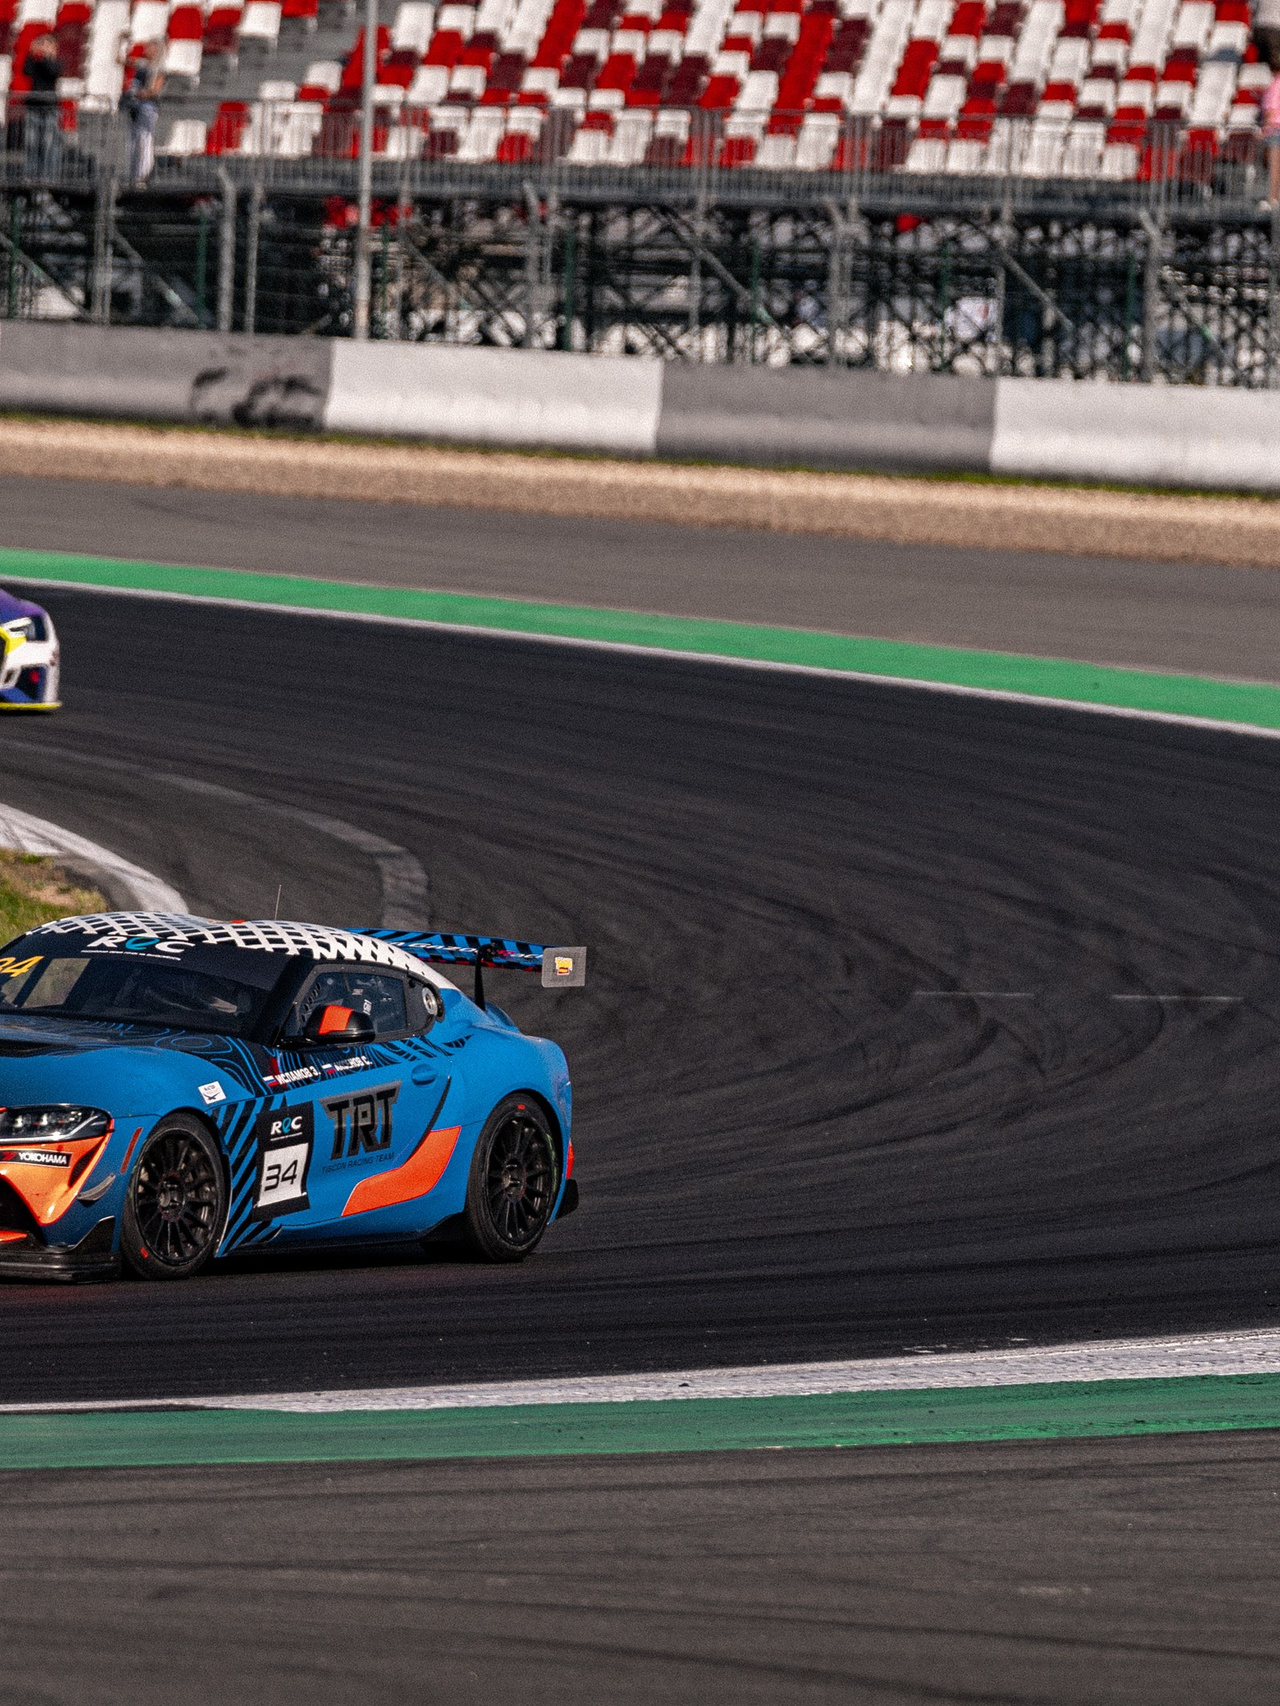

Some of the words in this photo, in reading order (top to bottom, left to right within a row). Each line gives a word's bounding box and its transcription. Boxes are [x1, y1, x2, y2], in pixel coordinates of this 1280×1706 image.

[320, 1082, 401, 1160] TRT
[18, 1152, 67, 1165] YOKOHAMA
[263, 1159, 298, 1192] 34
